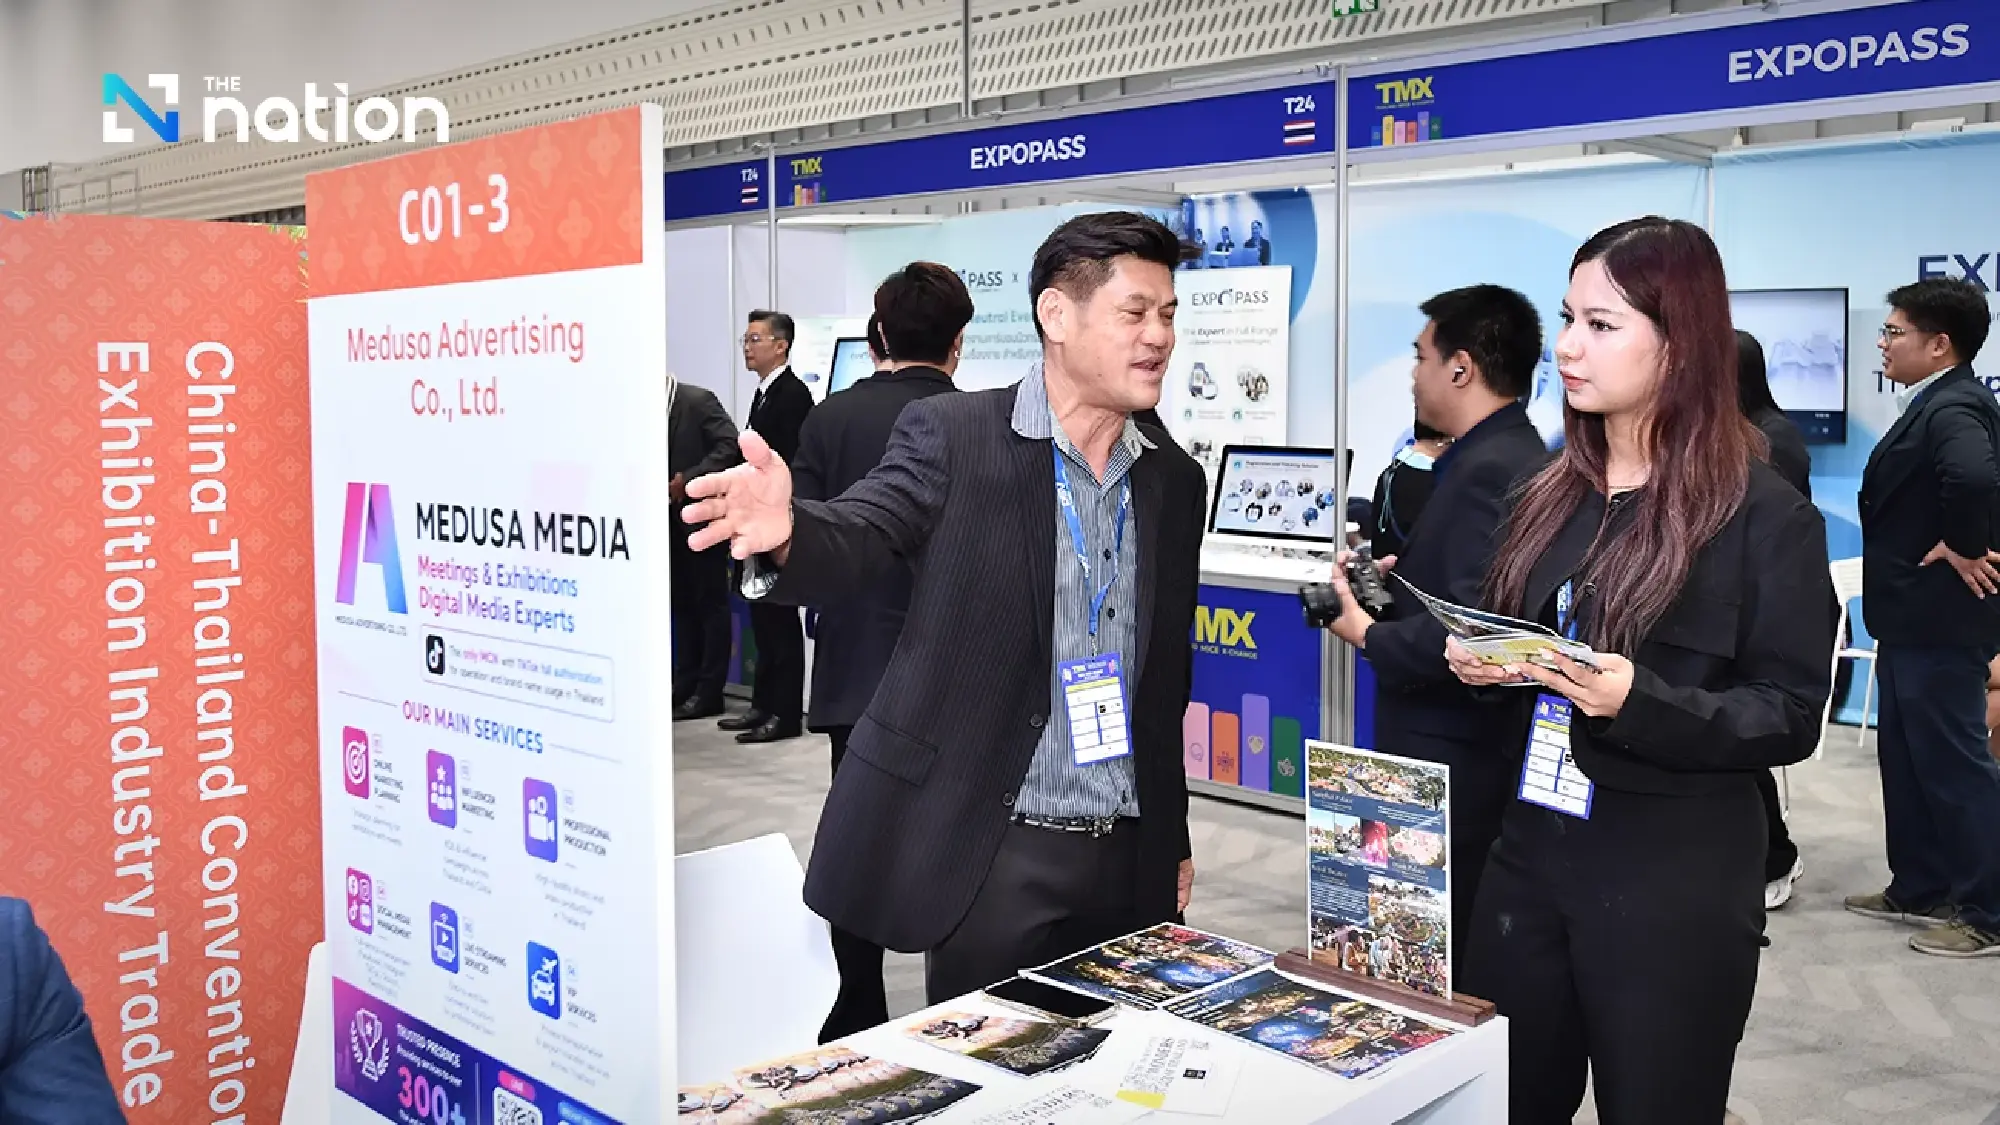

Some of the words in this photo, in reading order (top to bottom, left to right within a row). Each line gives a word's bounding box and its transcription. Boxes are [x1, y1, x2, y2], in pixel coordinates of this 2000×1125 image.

[1727, 23, 1971, 84] EXPOPASS
[1283, 94, 1316, 115] T24
[1374, 75, 1435, 104] TMX
[741, 168, 759, 182] T24
[791, 157, 823, 176] TMX
[970, 134, 1087, 170] EXPOPASS
[399, 174, 510, 246] C01-3
[964, 269, 1003, 290] PASS
[1918, 252, 2000, 292] EX
[348, 324, 432, 362] Medusa
[438, 314, 585, 363] Advertising
[971, 311, 1008, 324] eutral
[411, 379, 453, 422] Co.,
[459, 376, 505, 416] Ltd.
[97, 342, 156, 652] Exhibition
[416, 501, 527, 550] MEDUSA
[533, 511, 631, 561] MEDIA
[185, 341, 248, 801] China-Thailand
[417, 554, 479, 589] Meetings
[482, 562, 493, 586] &
[496, 562, 579, 598] Exhibitions
[419, 585, 464, 617] Digital
[467, 592, 511, 622] Media
[514, 599, 576, 633] Experts
[1195, 605, 1257, 649] MX
[403, 699, 432, 726] OUR
[434, 707, 471, 735] MAIN
[474, 716, 543, 754] SERVICES
[104, 667, 164, 917] Industry
[119, 930, 174, 1108] Trade
[398, 1065, 466, 1125] 300+
